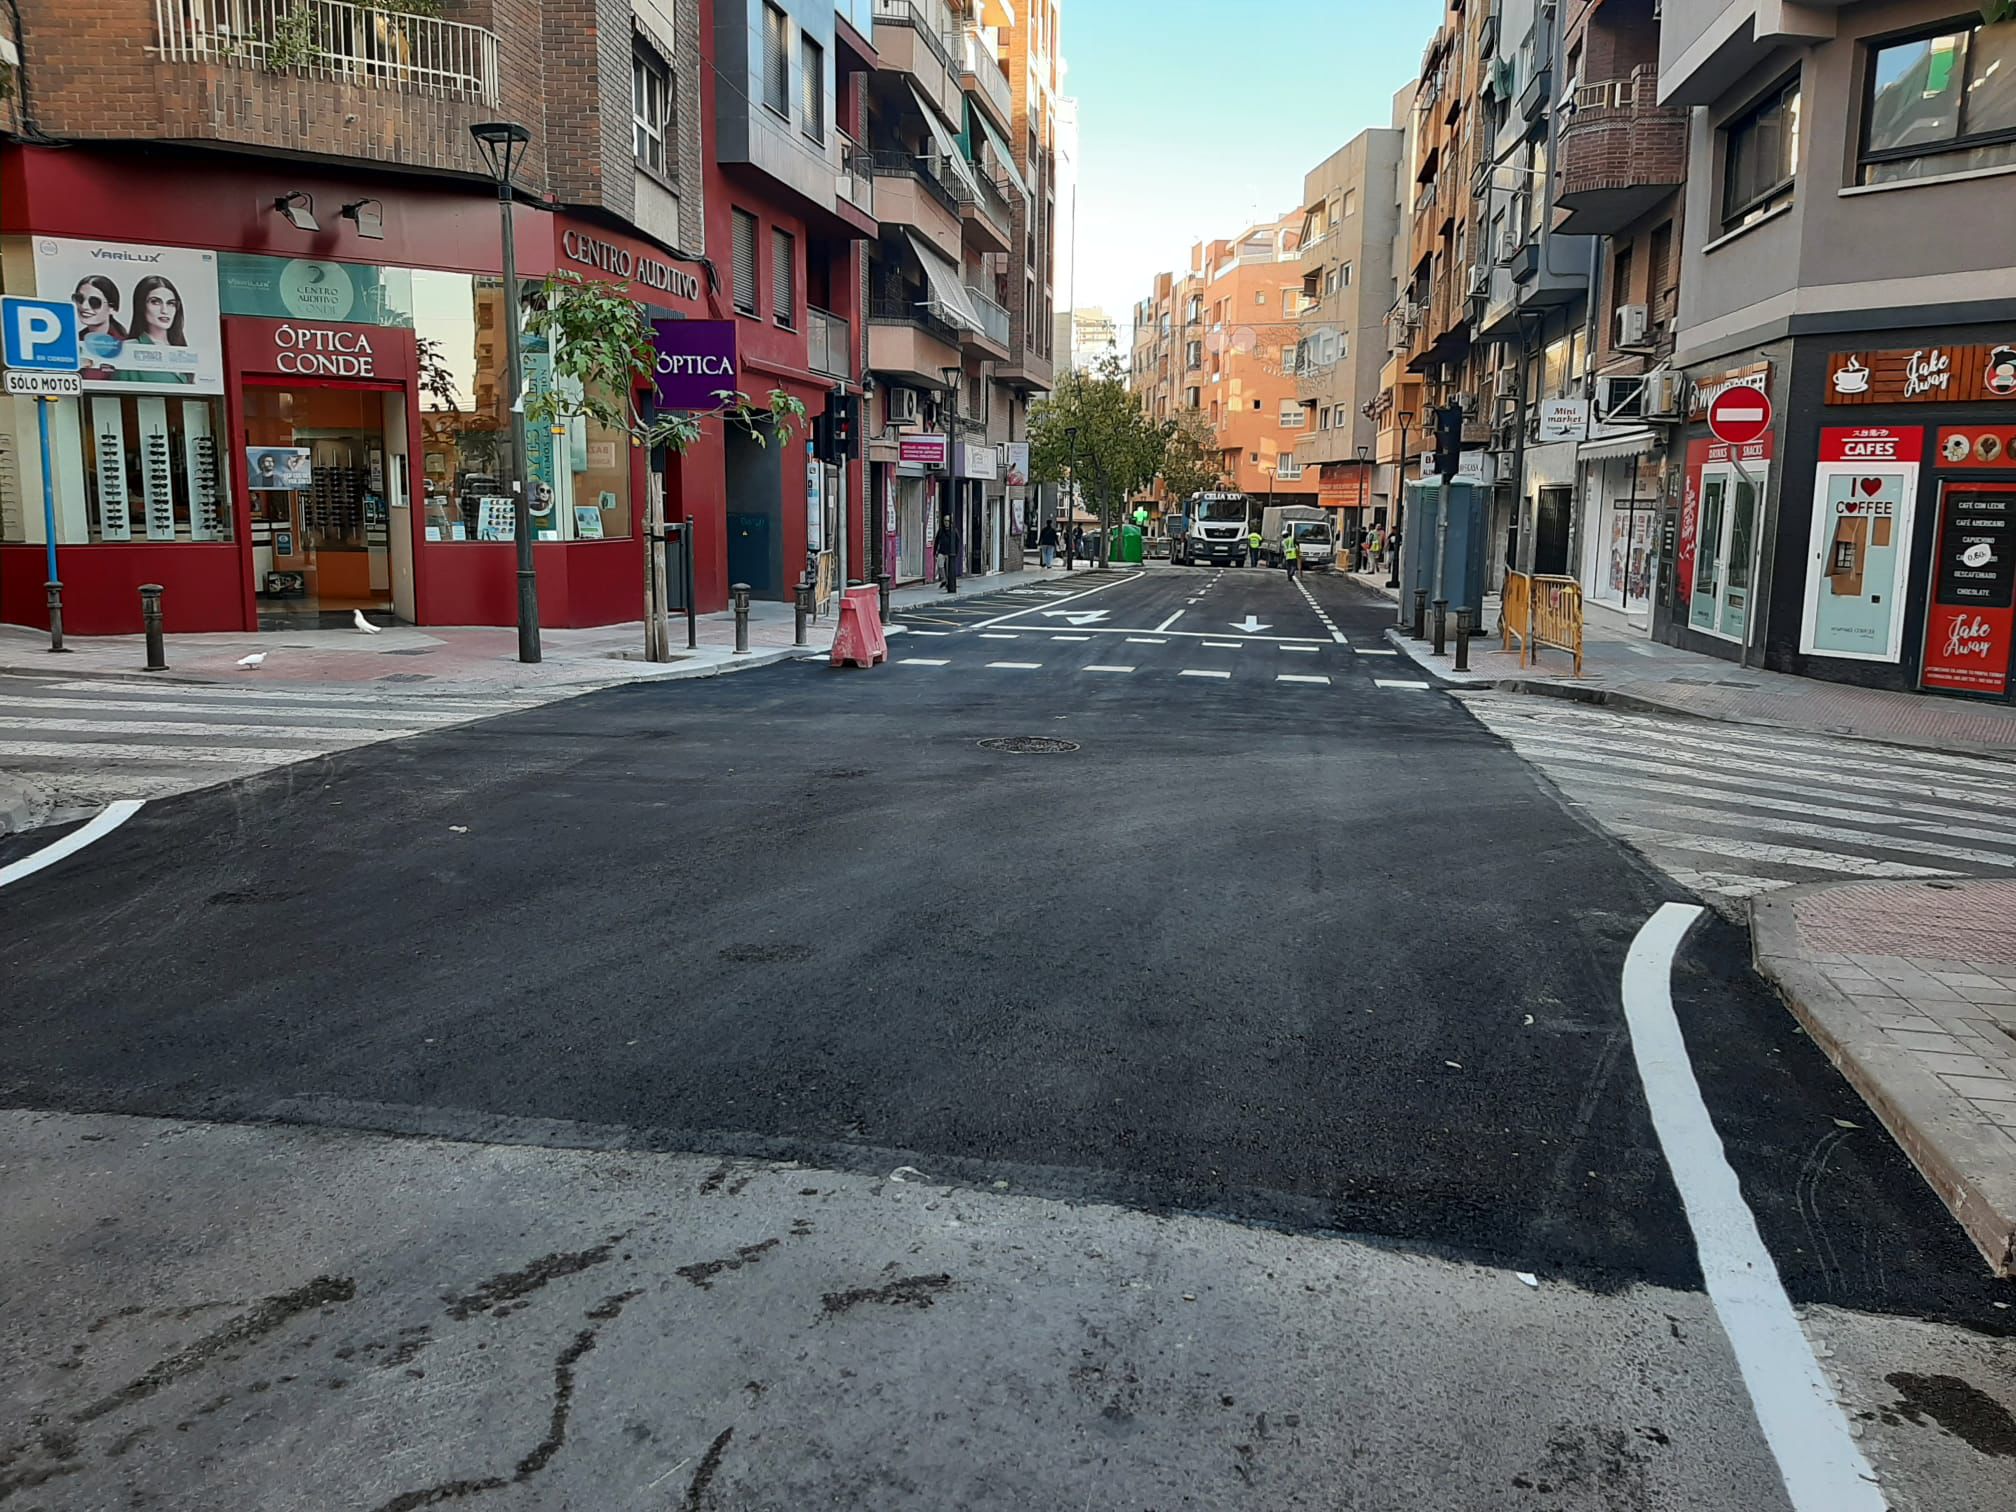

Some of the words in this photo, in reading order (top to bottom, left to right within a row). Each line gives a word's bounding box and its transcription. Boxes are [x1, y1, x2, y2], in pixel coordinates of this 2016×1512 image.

[90, 248, 161, 263] VARILUX
[563, 229, 632, 277] CENTRO
[636, 256, 699, 300] AUDITIVO
[296, 286, 339, 296] CENTRO
[297, 295, 339, 304] AUDITIVO
[17, 306, 62, 360] P
[275, 324, 373, 354] ÓPTICA
[276, 352, 375, 377] CONDE
[656, 351, 734, 375] ÓPTICA
[1902, 350, 1949, 379] Take
[11, 374, 38, 390] SÓLO
[41, 377, 78, 391] MOTOS
[1903, 373, 1950, 398] Away
[1547, 415, 1582, 424] market
[1554, 407, 1576, 415] Mini
[1742, 444, 1763, 457] SNACKS
[1844, 443, 1894, 455] CAFES
[1974, 502, 1986, 510] CON
[1947, 614, 1990, 639] Take
[1943, 638, 1991, 658] Away
